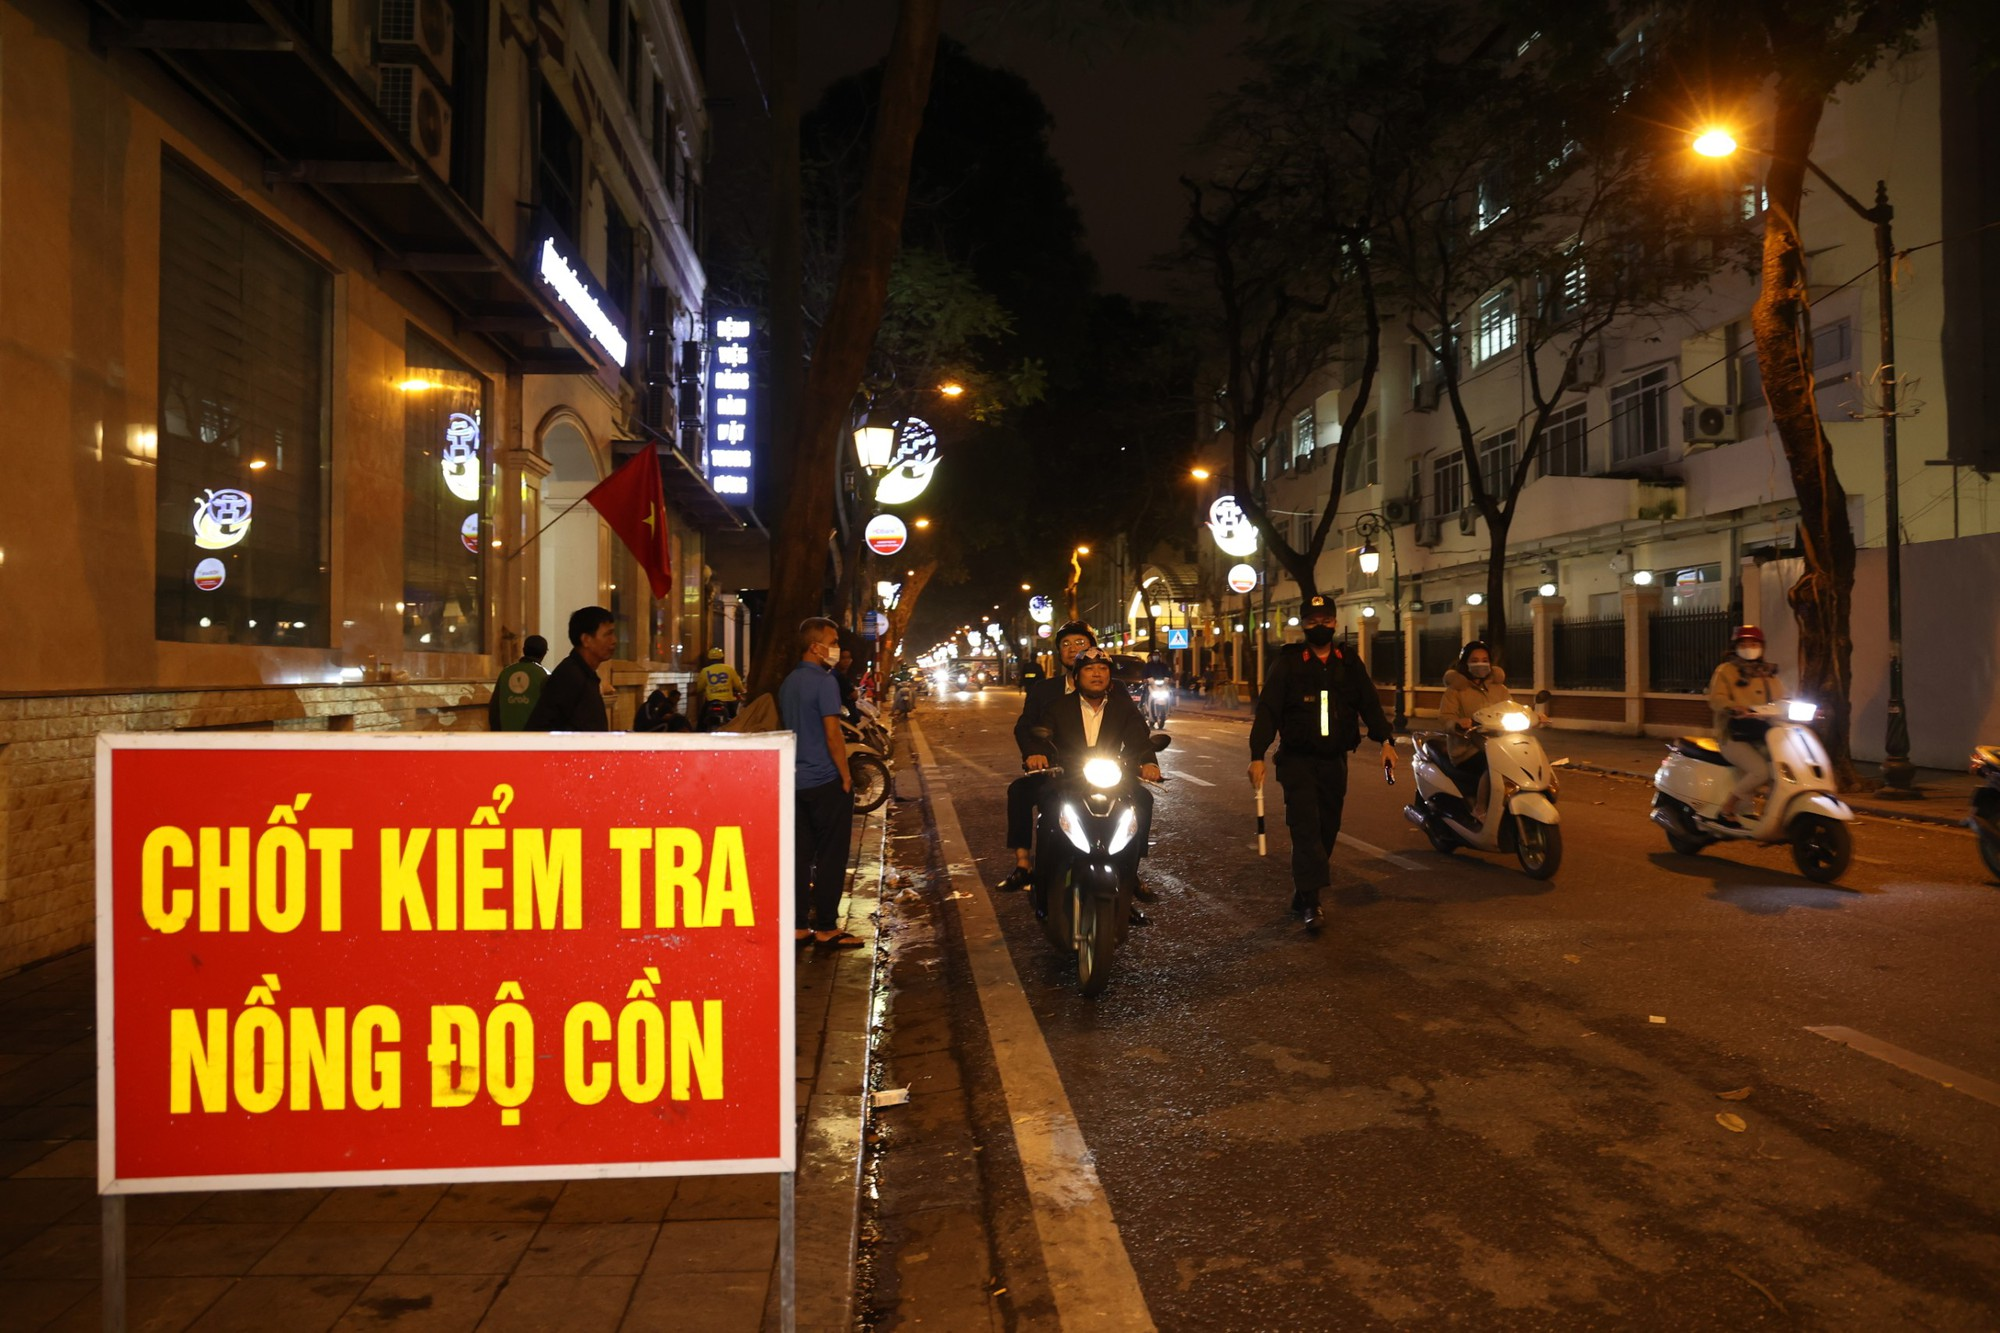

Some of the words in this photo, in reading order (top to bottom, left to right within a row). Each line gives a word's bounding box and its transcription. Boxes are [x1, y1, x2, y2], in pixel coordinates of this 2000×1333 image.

[507, 695, 530, 704] Grab
[706, 670, 729, 685] be
[142, 793, 352, 933] CHỐT
[381, 784, 582, 930] KIỂM
[610, 826, 754, 928] TRA
[171, 974, 400, 1113] NỒNG
[428, 982, 534, 1125] ĐỘ
[564, 967, 723, 1105] CỒN
